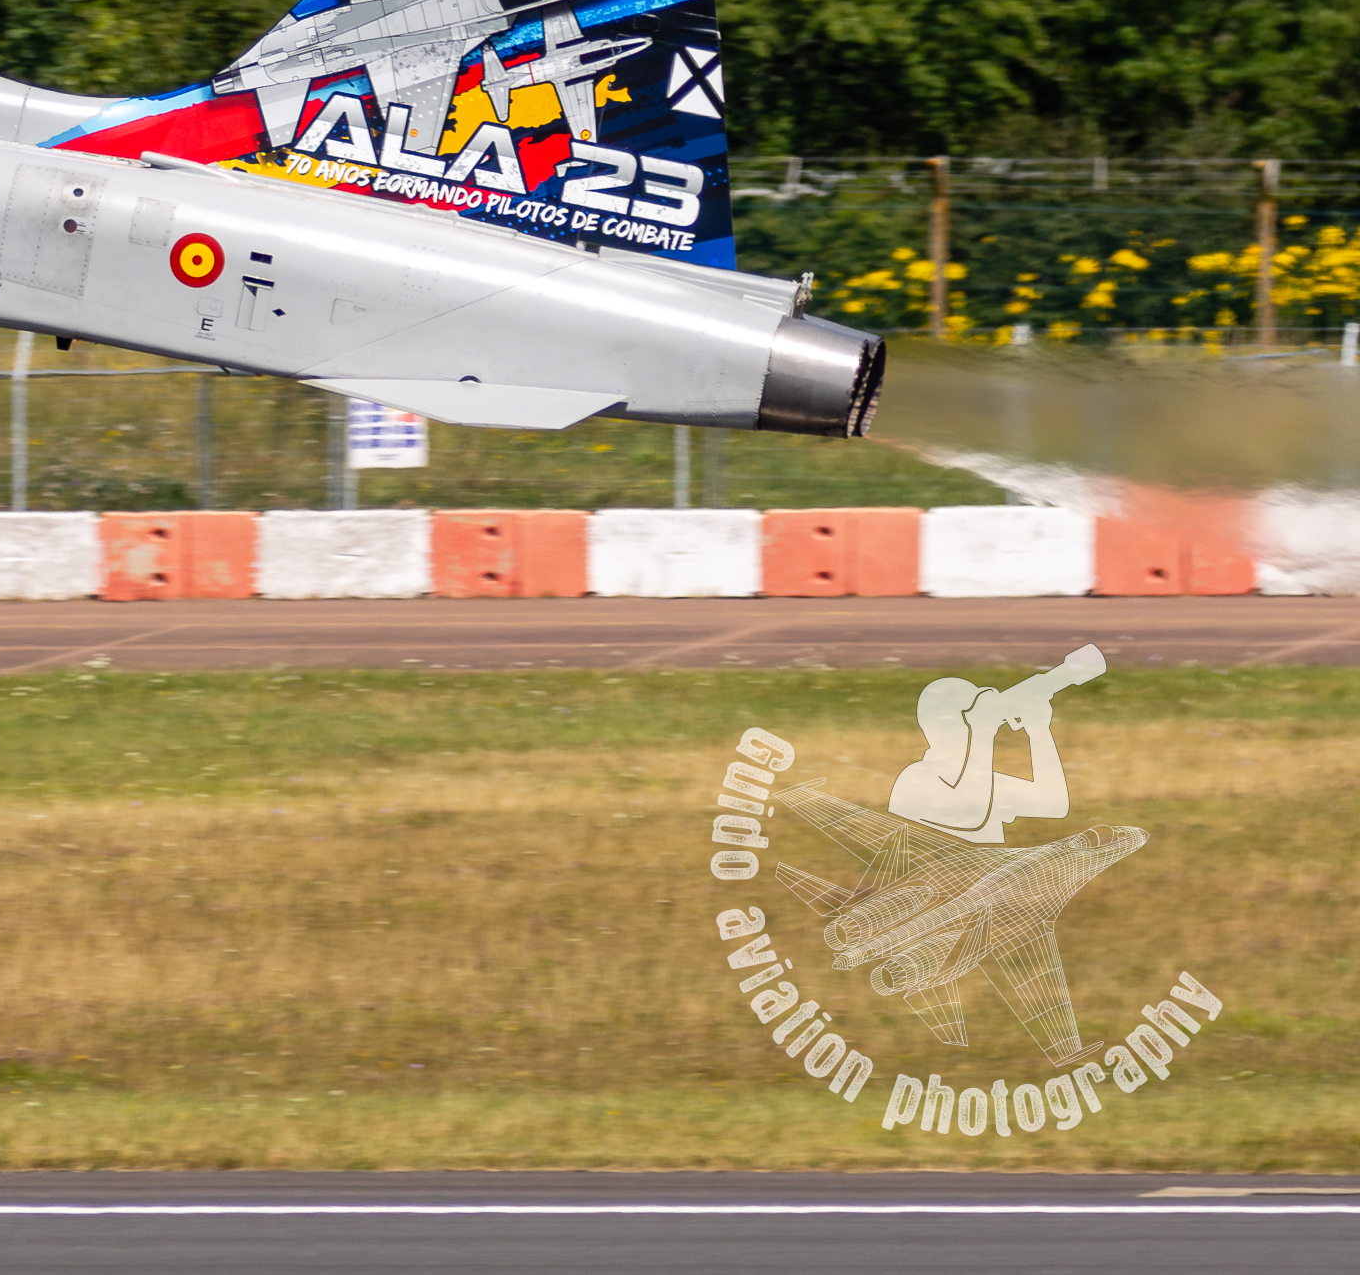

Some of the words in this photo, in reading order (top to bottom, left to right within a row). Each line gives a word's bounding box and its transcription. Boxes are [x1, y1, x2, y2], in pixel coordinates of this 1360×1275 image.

[286, 155, 312, 175] 70
[314, 159, 372, 187] AÑOS
[373, 172, 482, 208] FORMANDO
[485, 195, 569, 225] PILOTOS
[570, 211, 600, 231] DE
[602, 218, 696, 251] COMBATE
[294, 94, 527, 194] ALA
[561, 141, 704, 226] 23
[201, 318, 214, 331] E
